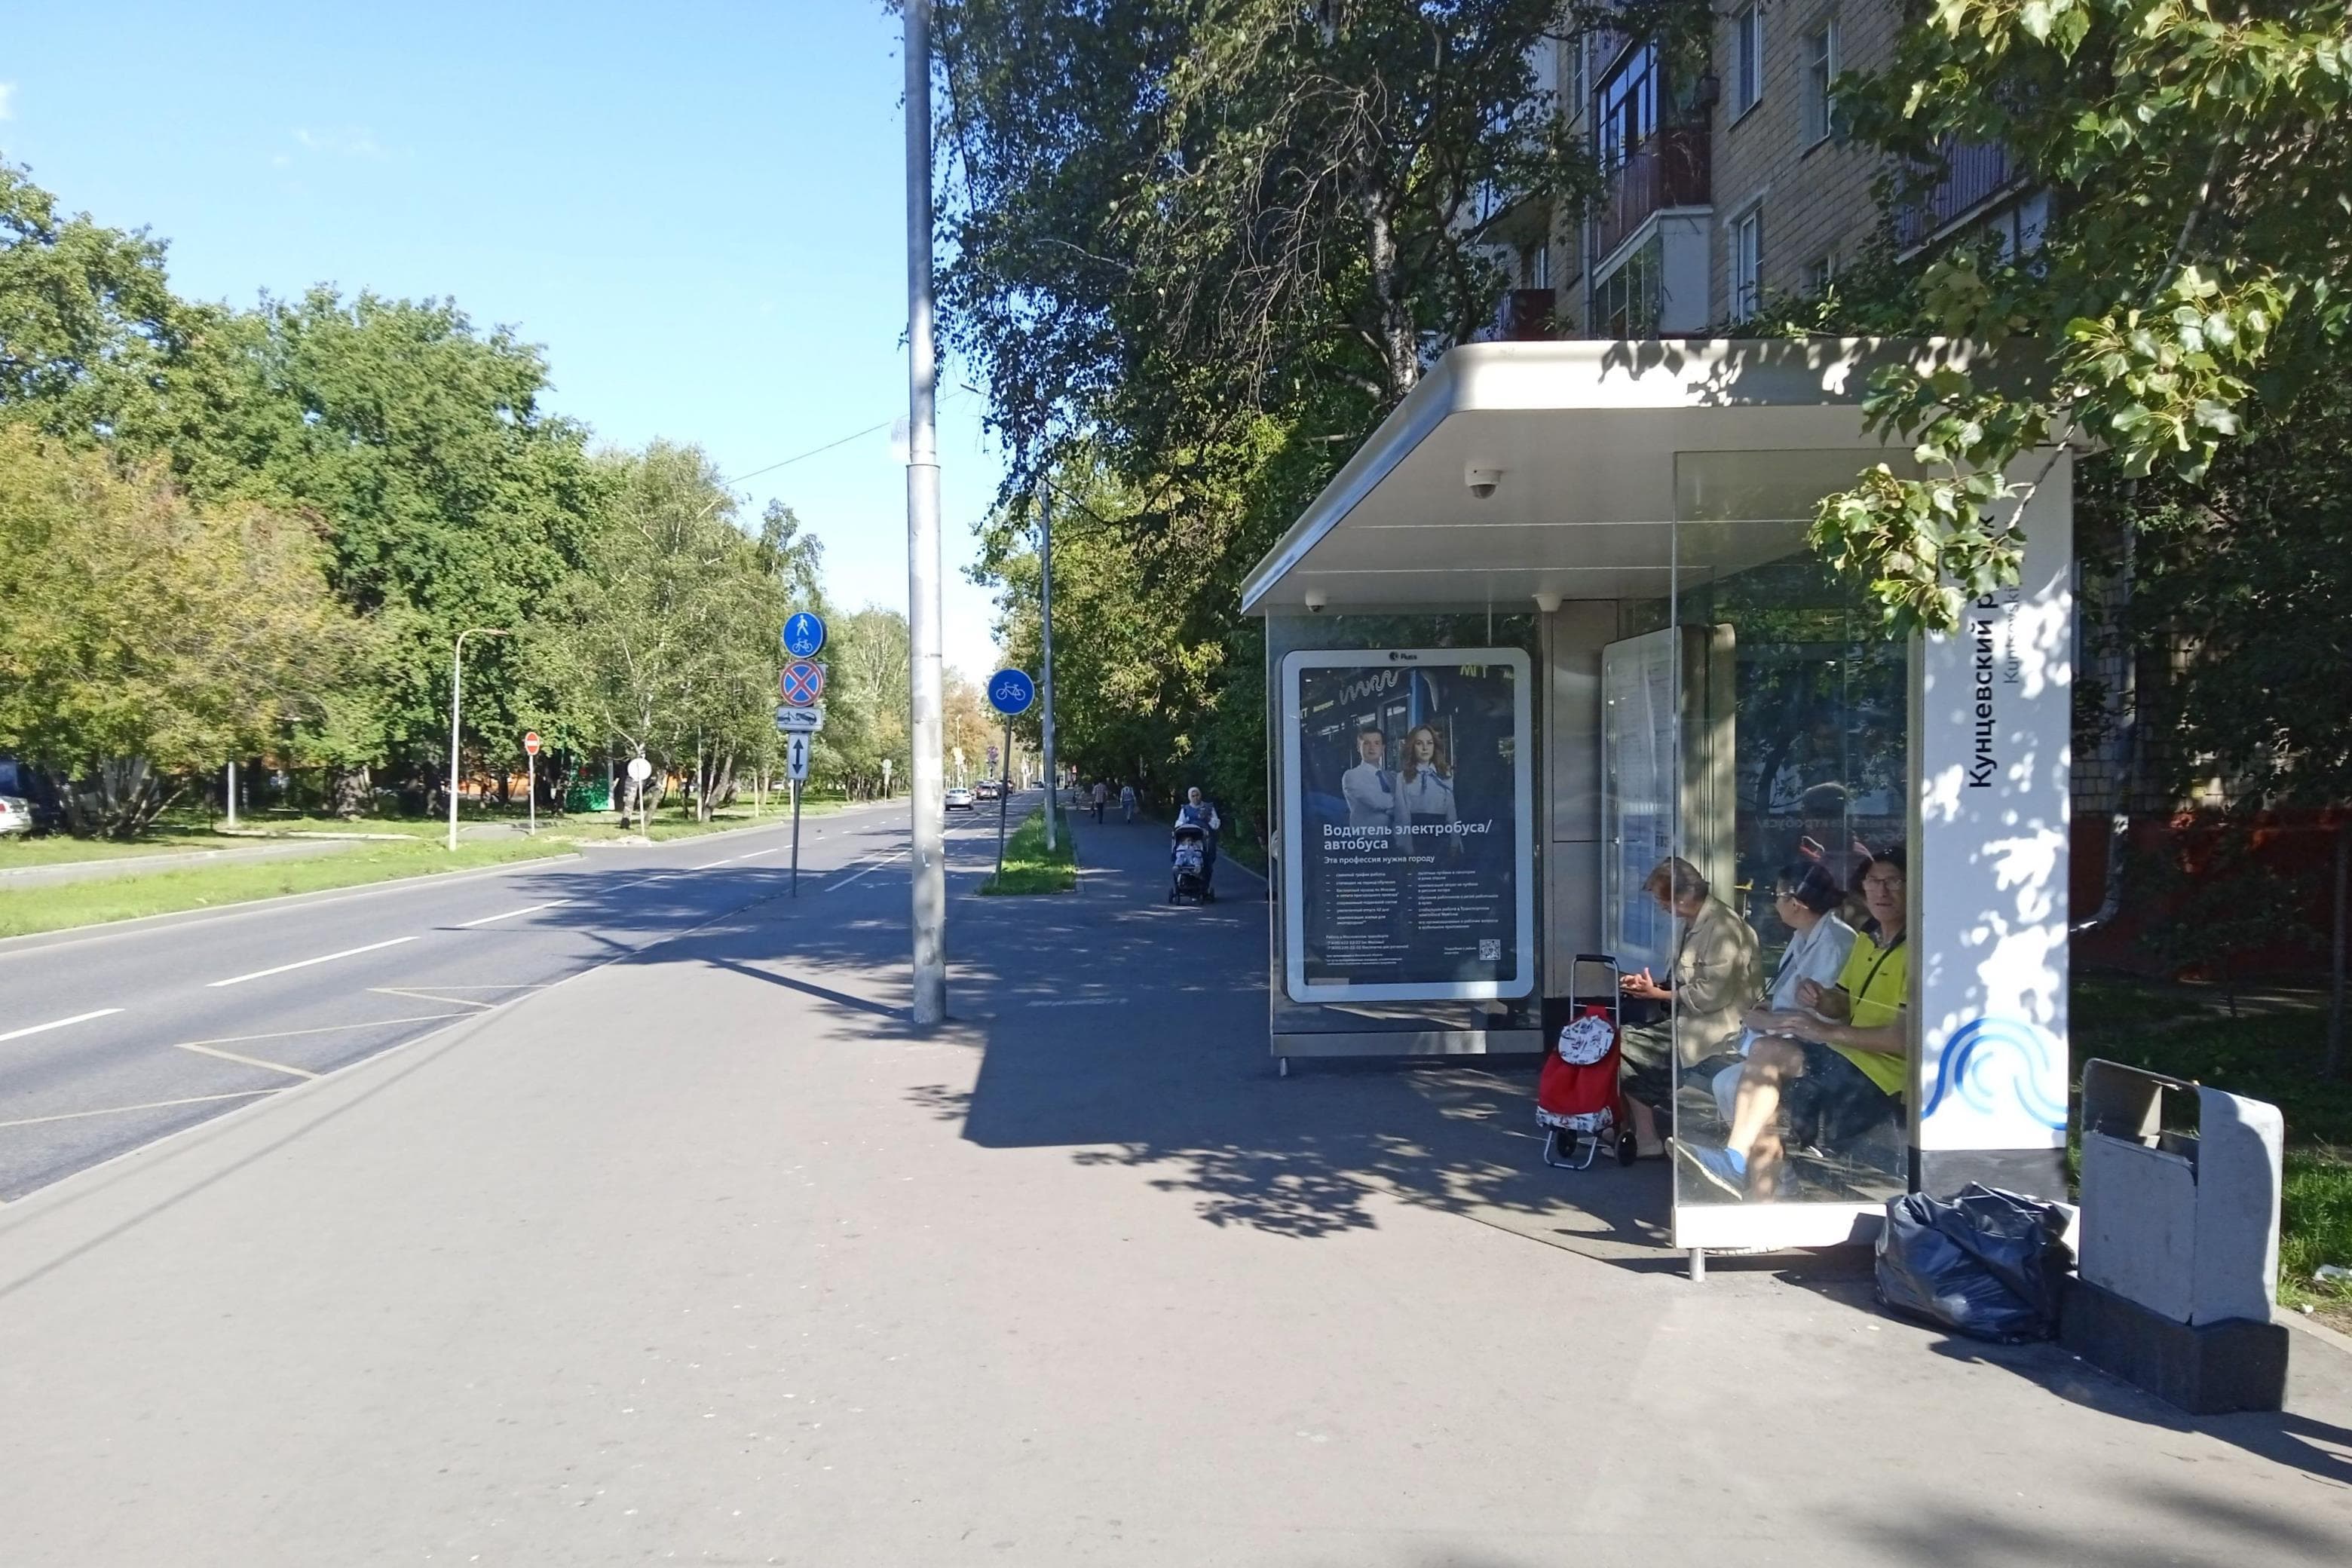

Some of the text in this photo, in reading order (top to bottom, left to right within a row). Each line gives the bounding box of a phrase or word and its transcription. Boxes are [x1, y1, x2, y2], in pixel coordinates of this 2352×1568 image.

[2003, 582, 2021, 684] Kuntvski
[1969, 620, 1998, 788] Кунцевский
[1324, 819, 1493, 838] Водитель электробуса/
[1325, 837, 1389, 852] автобуса
[1340, 856, 1382, 865] профессия
